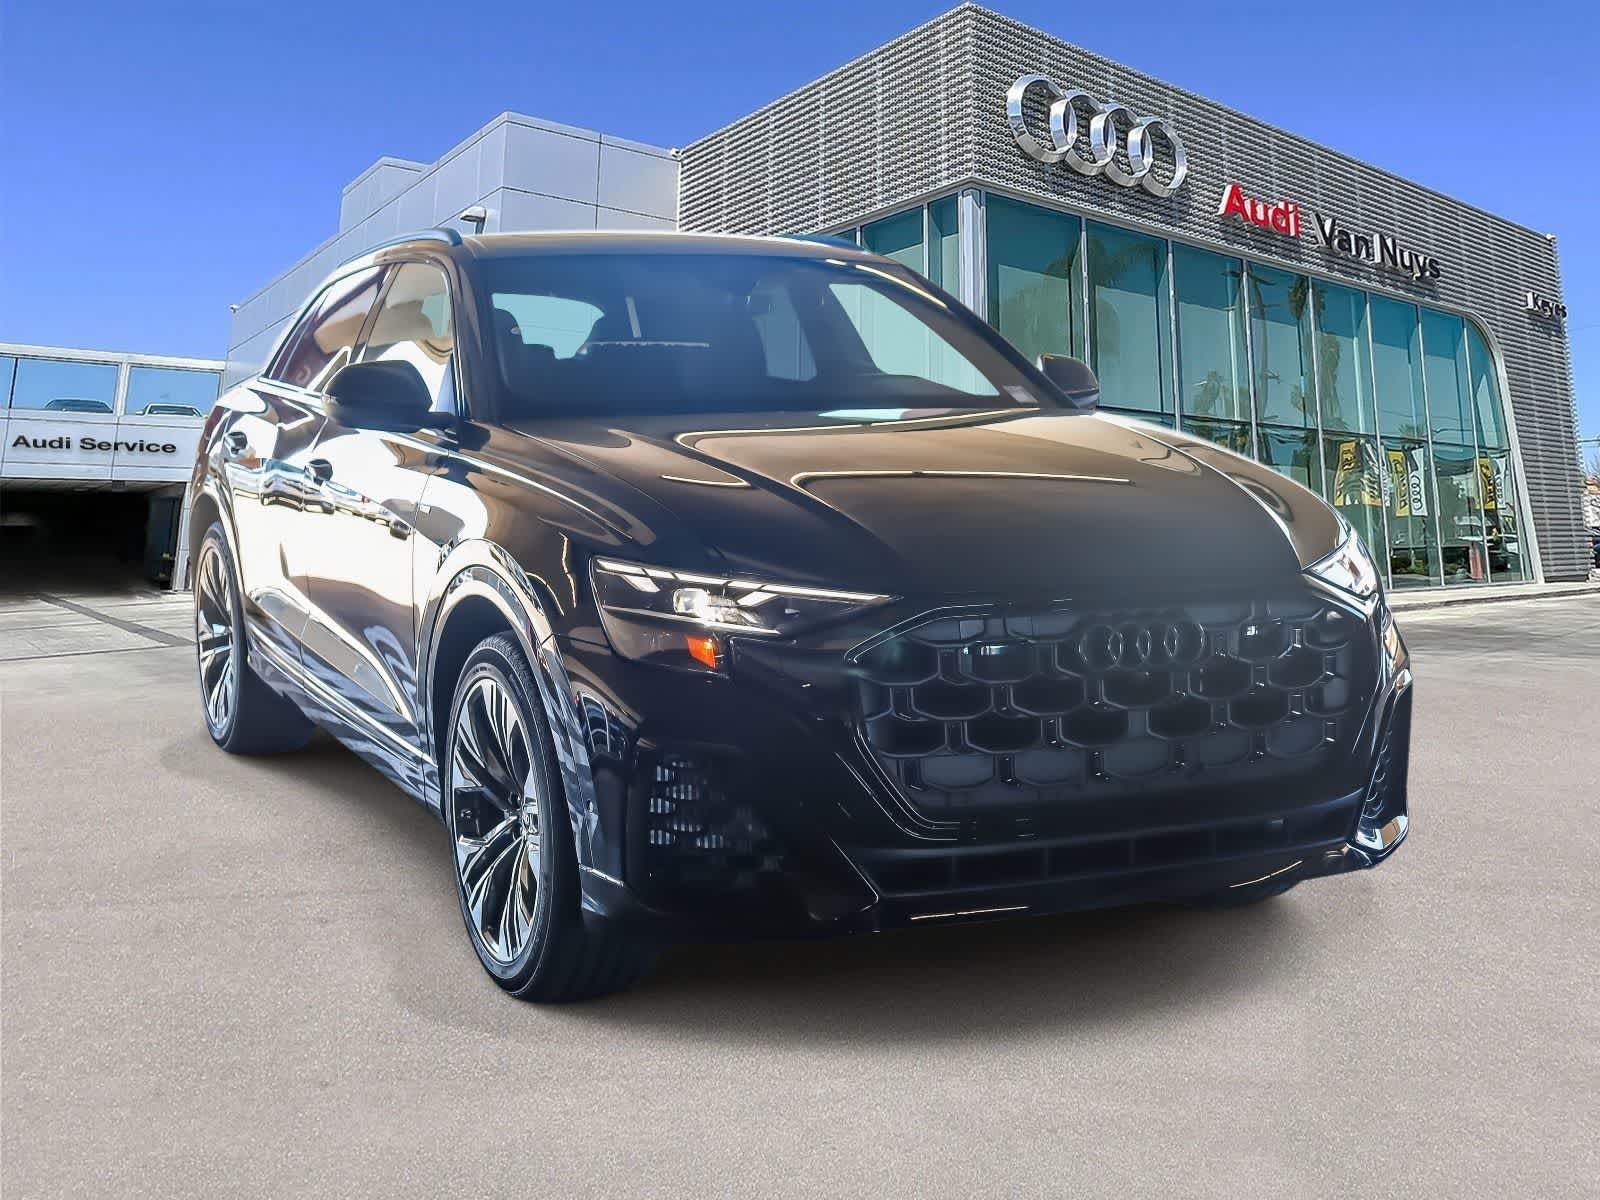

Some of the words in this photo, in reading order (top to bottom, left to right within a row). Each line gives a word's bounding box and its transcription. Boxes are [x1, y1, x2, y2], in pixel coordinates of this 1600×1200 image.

[1219, 182, 1301, 237] Audi
[1311, 212, 1371, 260] Van
[1374, 232, 1440, 280] Nuys
[12, 435, 71, 450] Audi
[79, 437, 177, 454] Service
